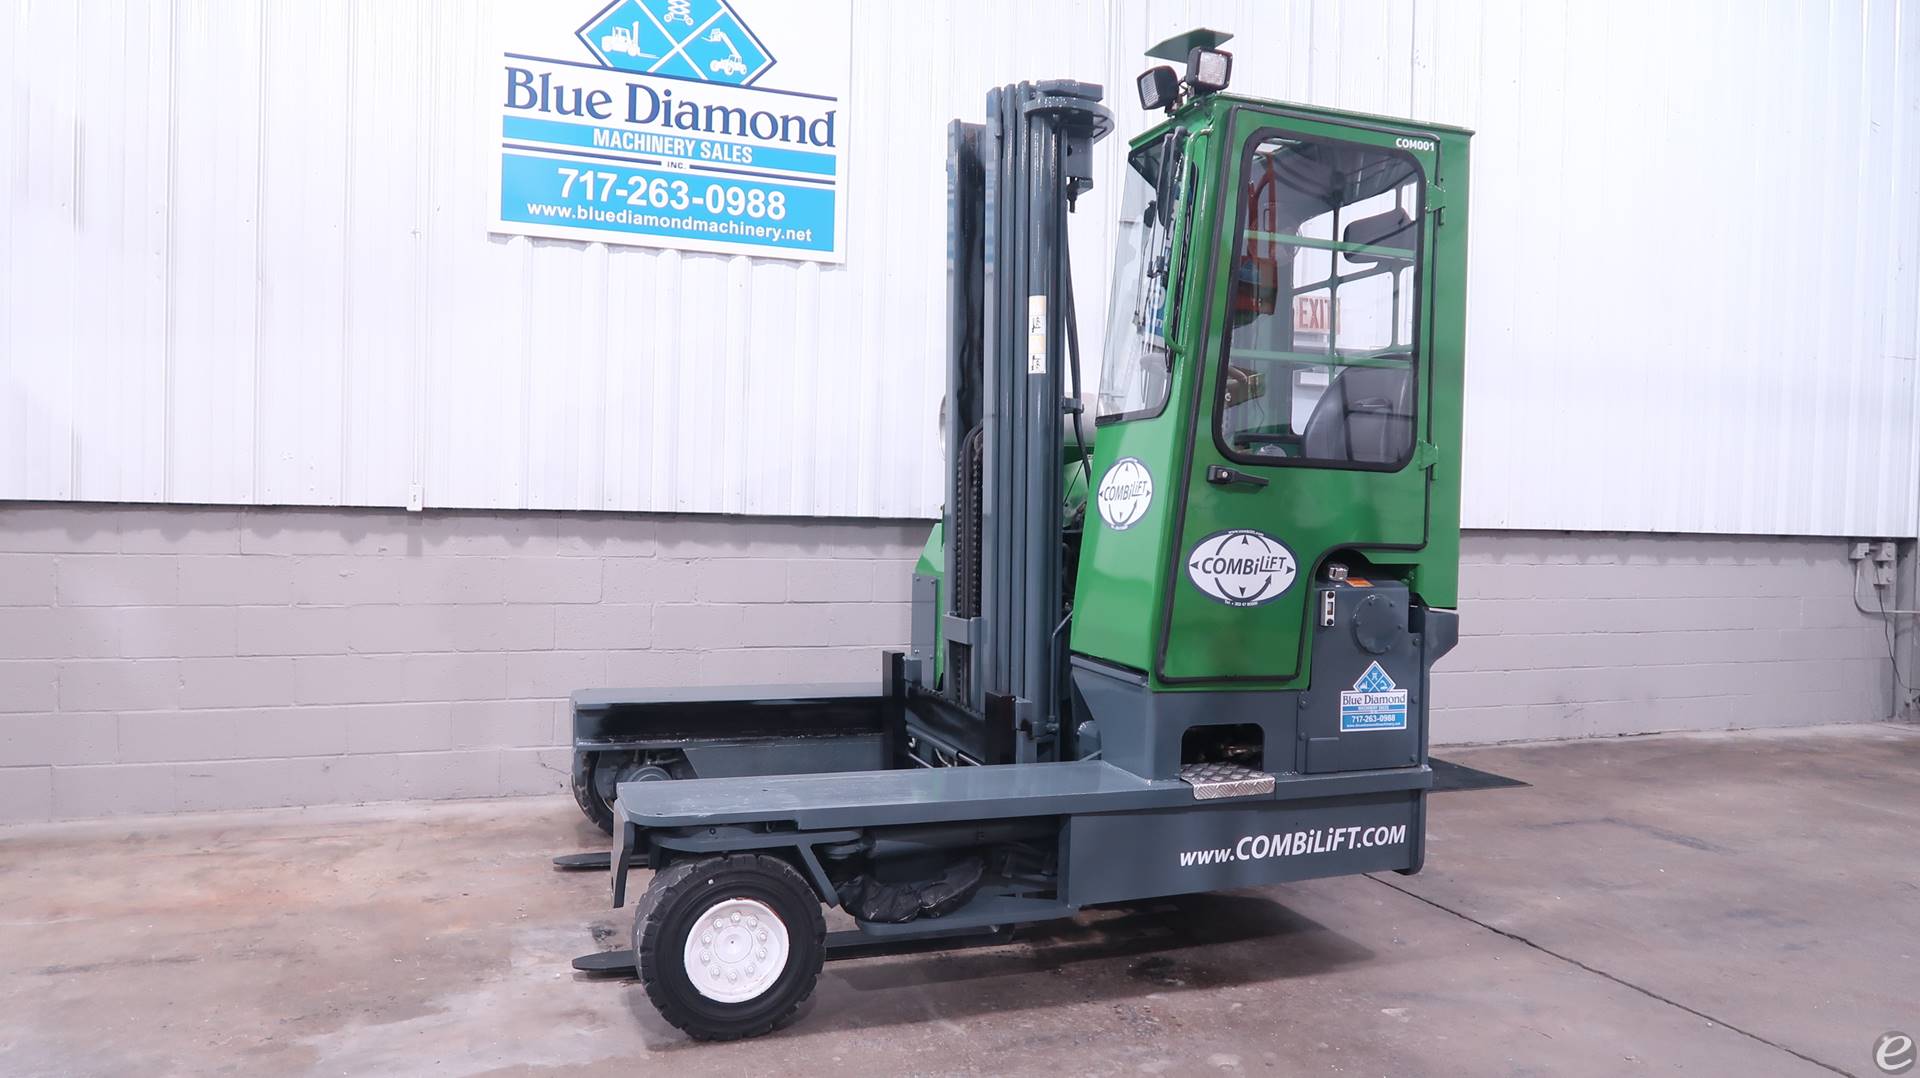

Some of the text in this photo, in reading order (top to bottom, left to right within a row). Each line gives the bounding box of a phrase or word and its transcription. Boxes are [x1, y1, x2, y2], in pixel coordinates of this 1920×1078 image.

[504, 66, 836, 148] Blue Diamond
[593, 128, 753, 164] MACHINERY SALES
[1395, 138, 1435, 152] COM001
[667, 161, 686, 170] INC.
[557, 167, 786, 220] 717-263-0988
[527, 201, 812, 242] www.bluediamondmachinery.net
[1343, 694, 1405, 705] Blue Diamond
